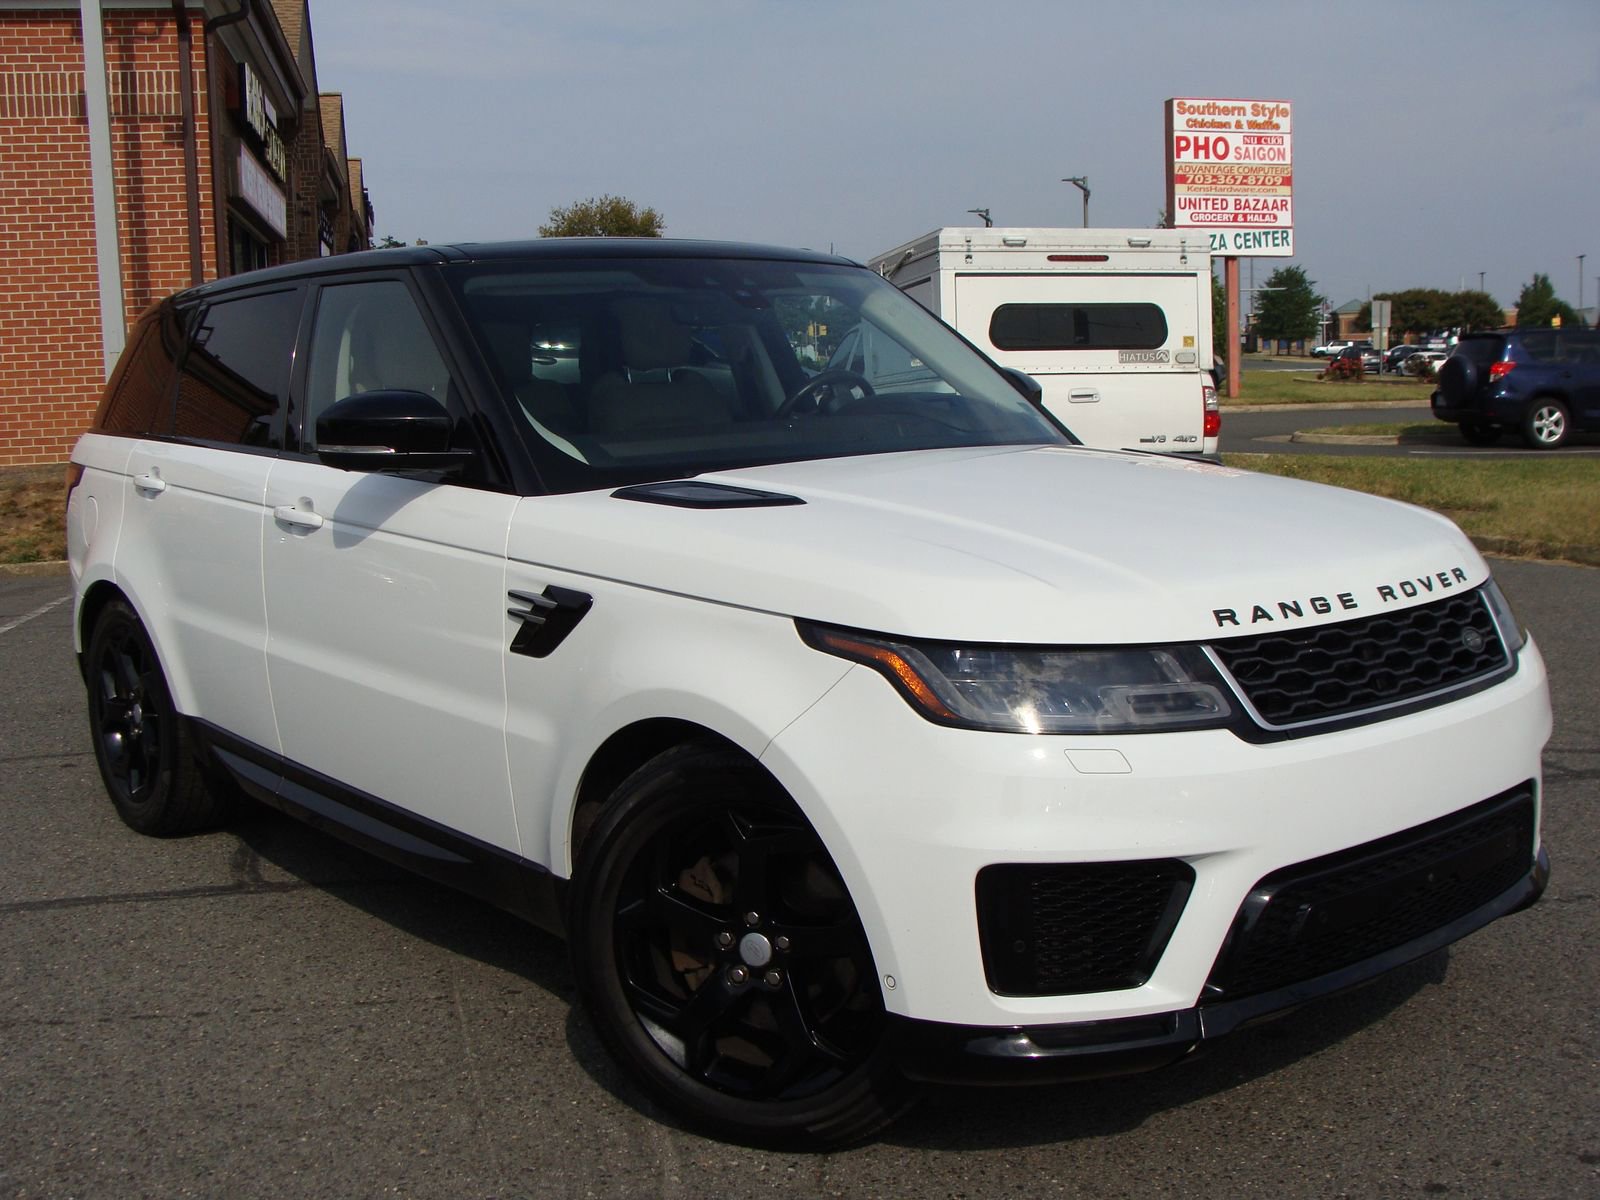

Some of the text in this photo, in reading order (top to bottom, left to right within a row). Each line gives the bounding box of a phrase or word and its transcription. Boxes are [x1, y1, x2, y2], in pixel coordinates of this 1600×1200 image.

[1176, 101, 1290, 120] Southern Style
[1234, 119, 1243, 130] &
[1175, 135, 1230, 160] PHO
[1234, 146, 1286, 161] SAIGON
[1177, 165, 1290, 175] ADVANTAGE COMPUTERS
[1186, 174, 1283, 185] 703-367-8709
[1187, 185, 1278, 194] KensHardware.com
[1178, 197, 1289, 211] UNITED BAZAAR
[1191, 213, 1276, 223] GROCERY & HALAL
[1233, 230, 1290, 250] CENTER
[1119, 351, 1157, 361] HIATUS
[1173, 435, 1198, 443] 4WD
[1212, 566, 1468, 627] RANGE ROVER
